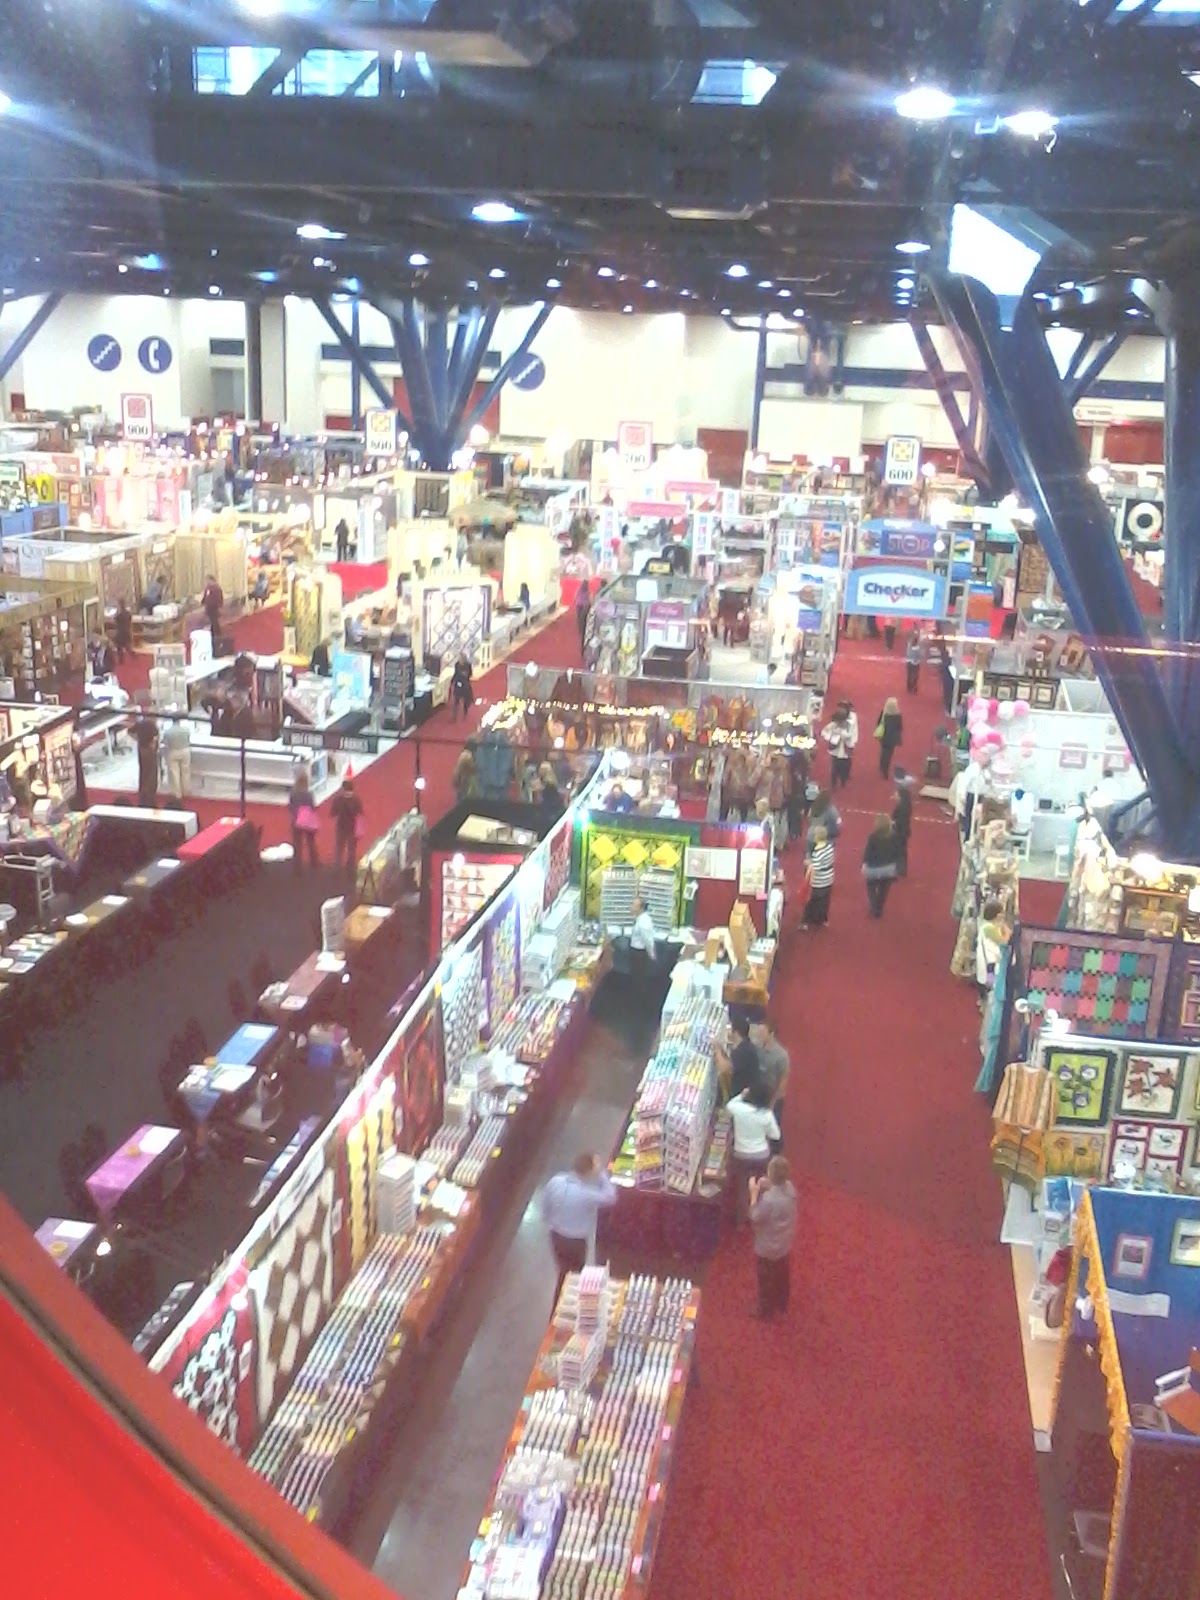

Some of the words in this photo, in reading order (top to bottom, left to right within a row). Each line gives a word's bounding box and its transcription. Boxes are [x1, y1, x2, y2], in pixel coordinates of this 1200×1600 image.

[127, 424, 149, 436] 900
[888, 468, 914, 481] 600
[863, 581, 930, 598] Checker
